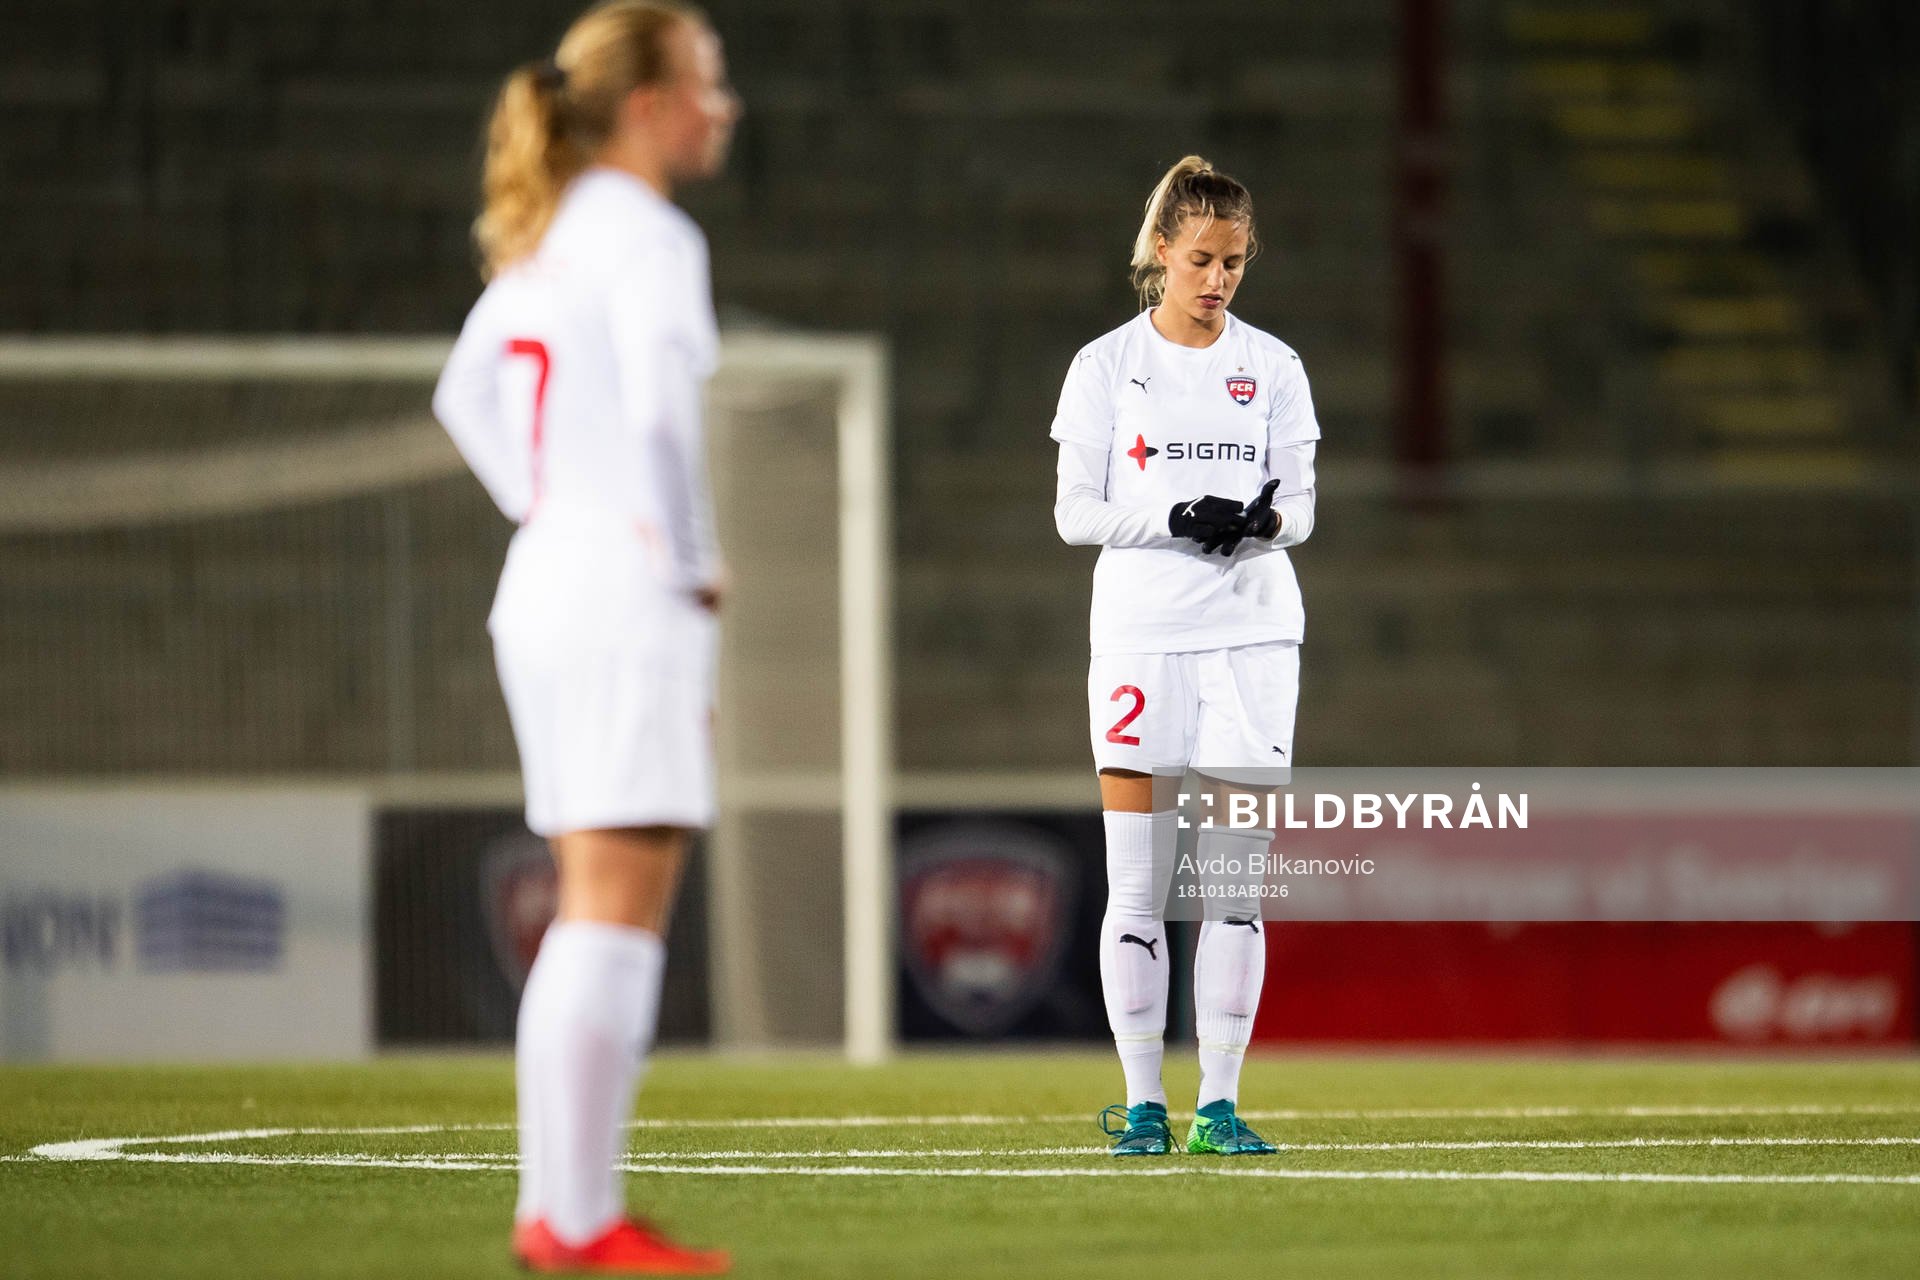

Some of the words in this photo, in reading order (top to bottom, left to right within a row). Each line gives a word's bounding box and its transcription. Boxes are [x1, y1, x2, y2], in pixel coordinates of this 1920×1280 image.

[1229, 383, 1254, 392] FCR
[503, 338, 551, 522] 7
[1105, 684, 1146, 746] 2
